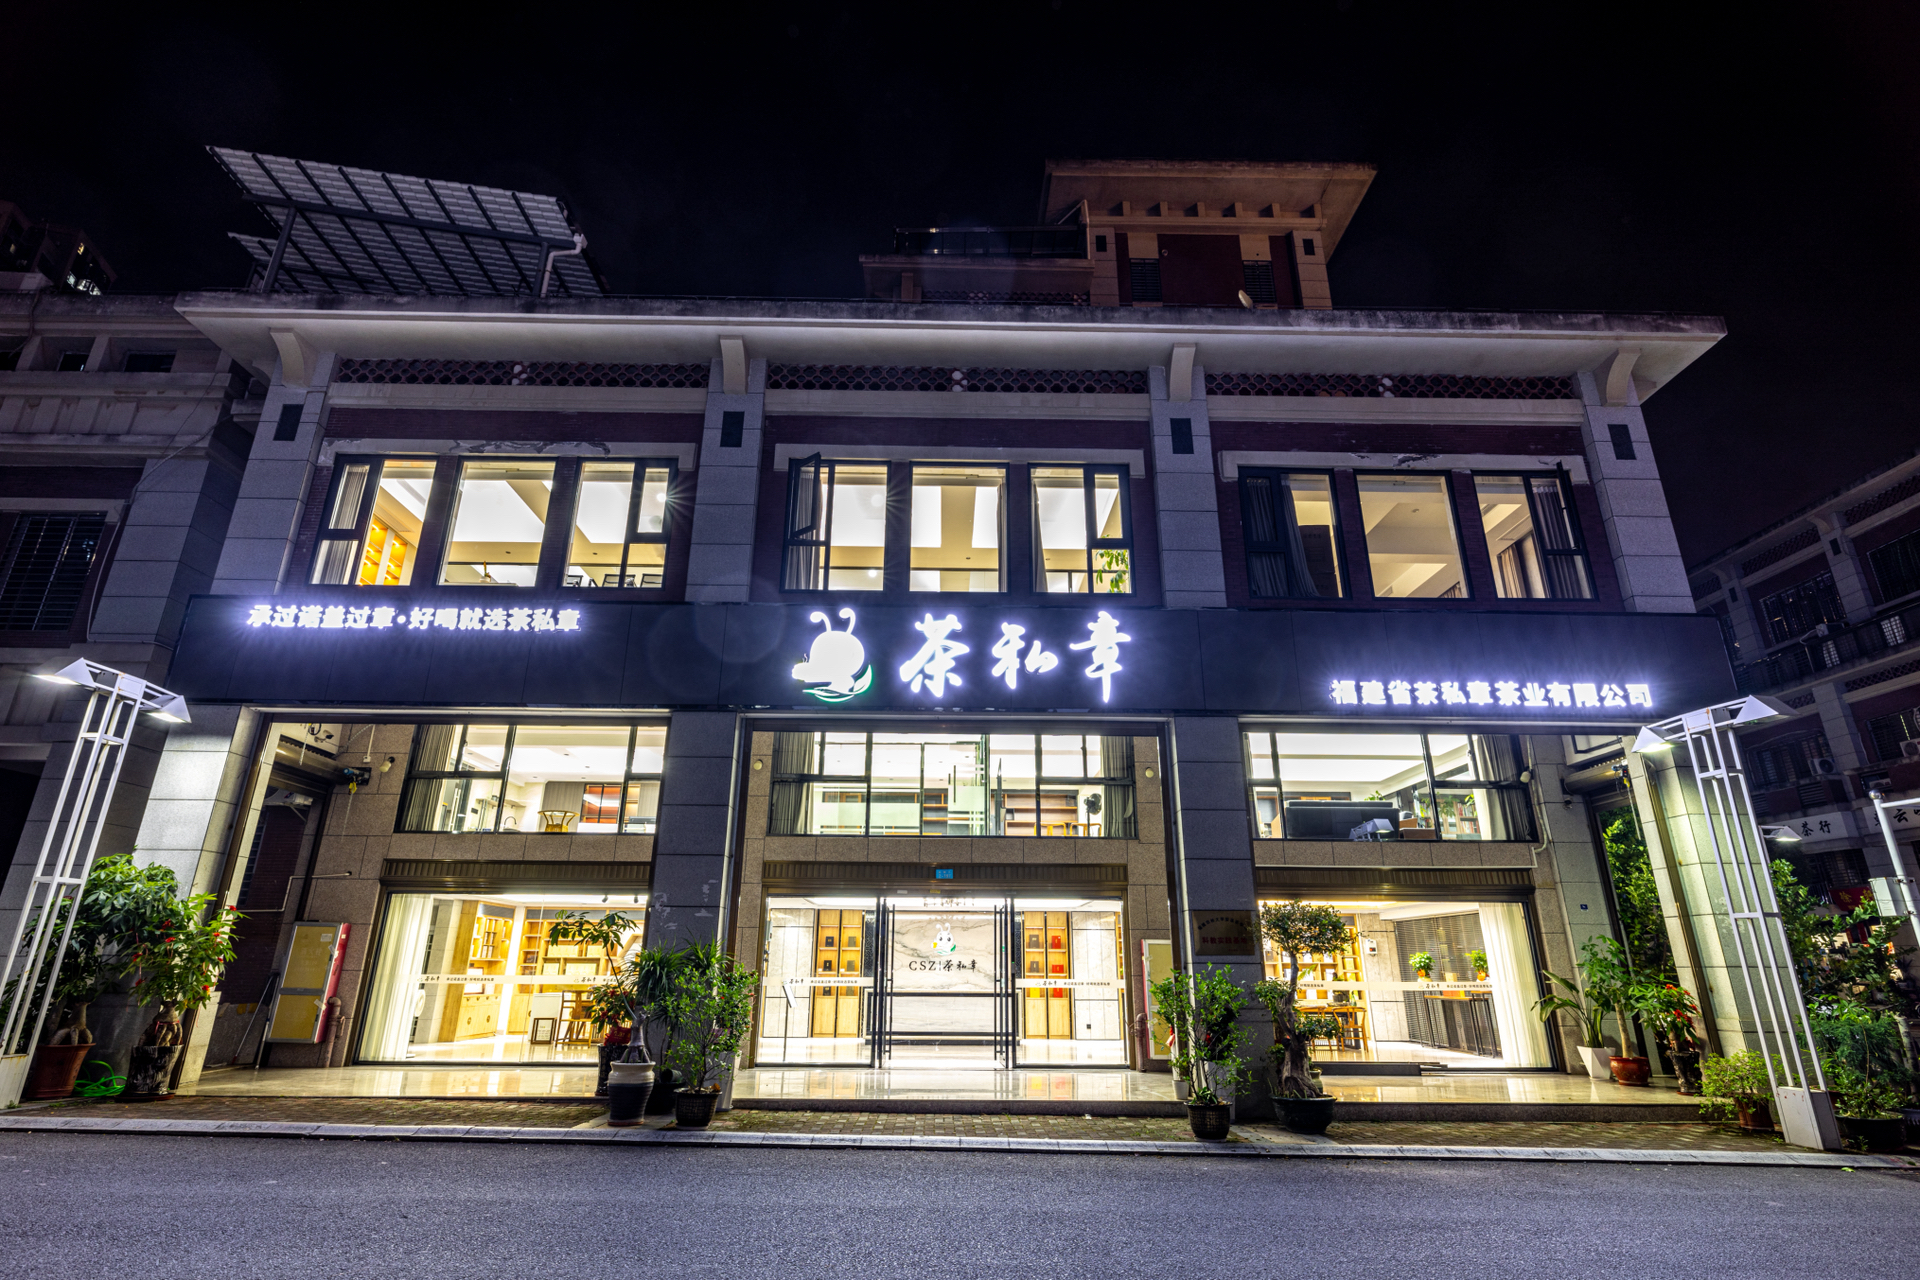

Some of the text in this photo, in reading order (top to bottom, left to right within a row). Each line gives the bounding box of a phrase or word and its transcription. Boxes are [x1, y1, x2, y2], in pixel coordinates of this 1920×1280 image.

[899, 610, 1132, 703] 茶私章
[1330, 680, 1653, 708] 福建省茶私章茶业有限公司
[908, 958, 978, 973] CSZ 茶私章
